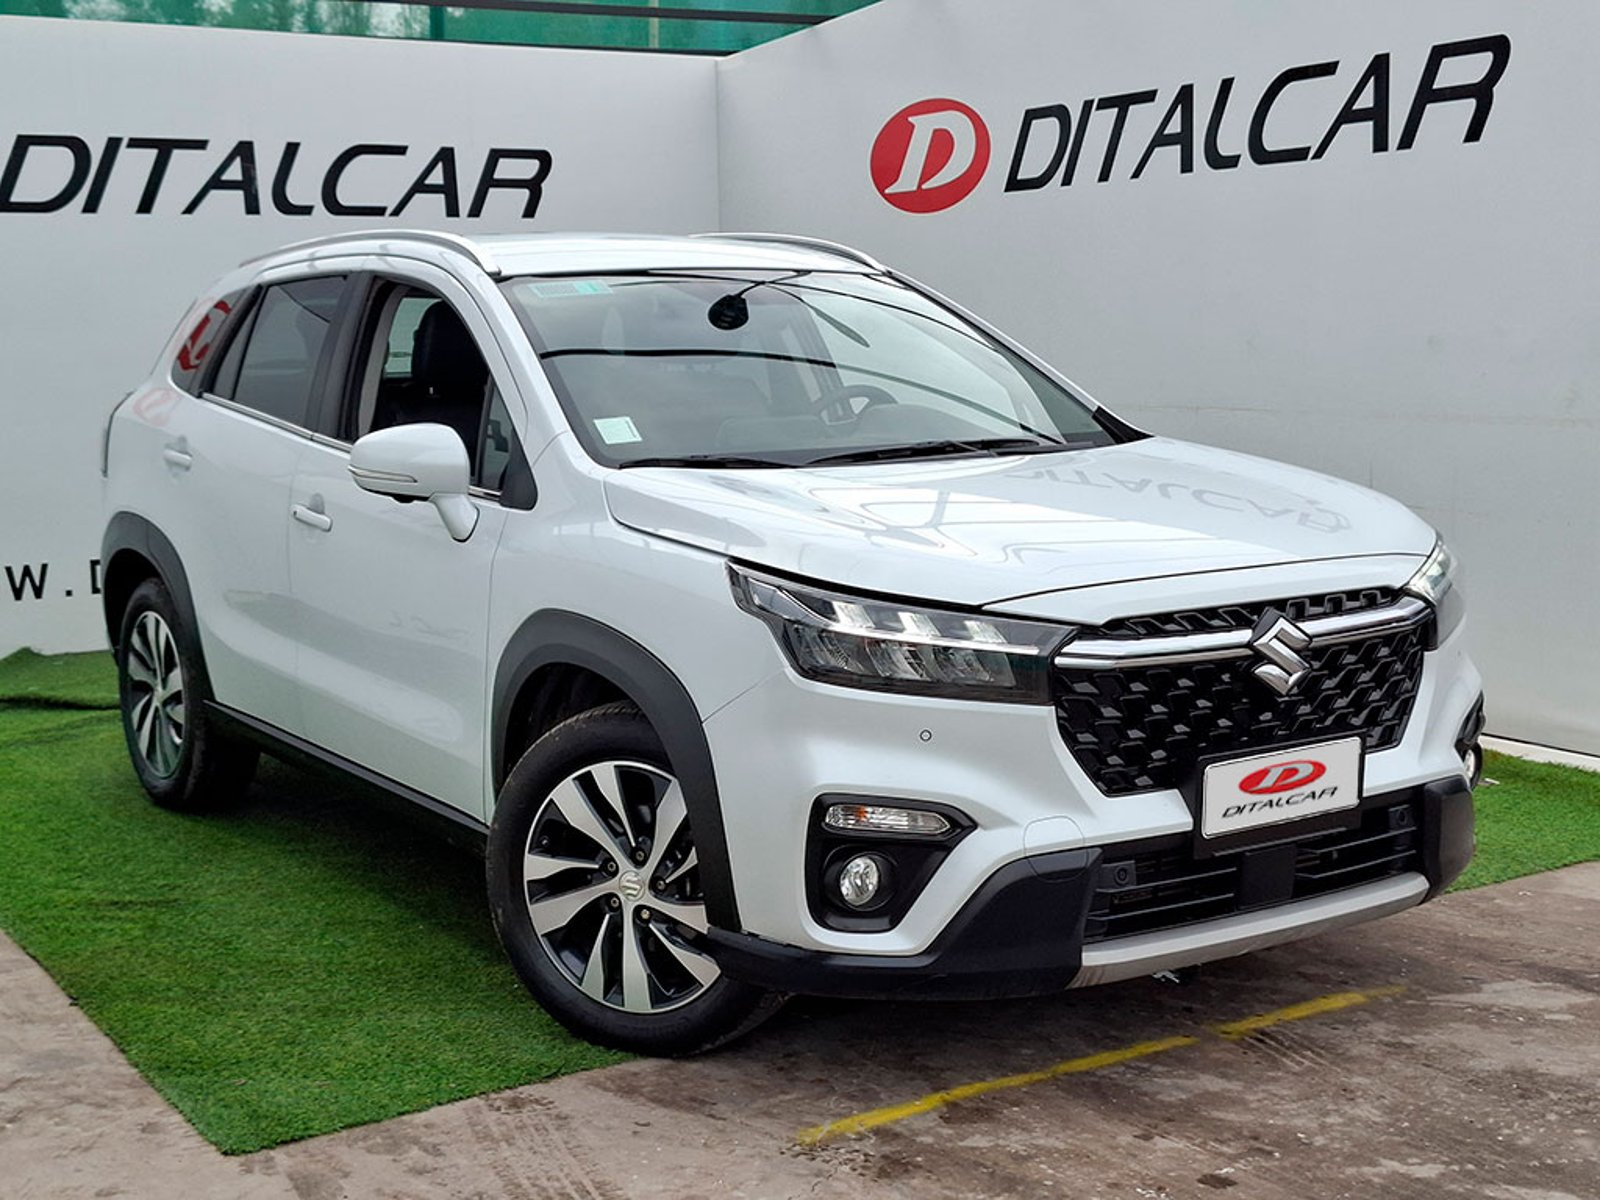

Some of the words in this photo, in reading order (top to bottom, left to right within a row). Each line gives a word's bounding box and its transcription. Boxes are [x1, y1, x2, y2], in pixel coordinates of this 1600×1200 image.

[1003, 34, 1512, 194] DITALCAR
[0, 134, 553, 218] DITALCAR
[1222, 786, 1338, 818] DITALCAR
